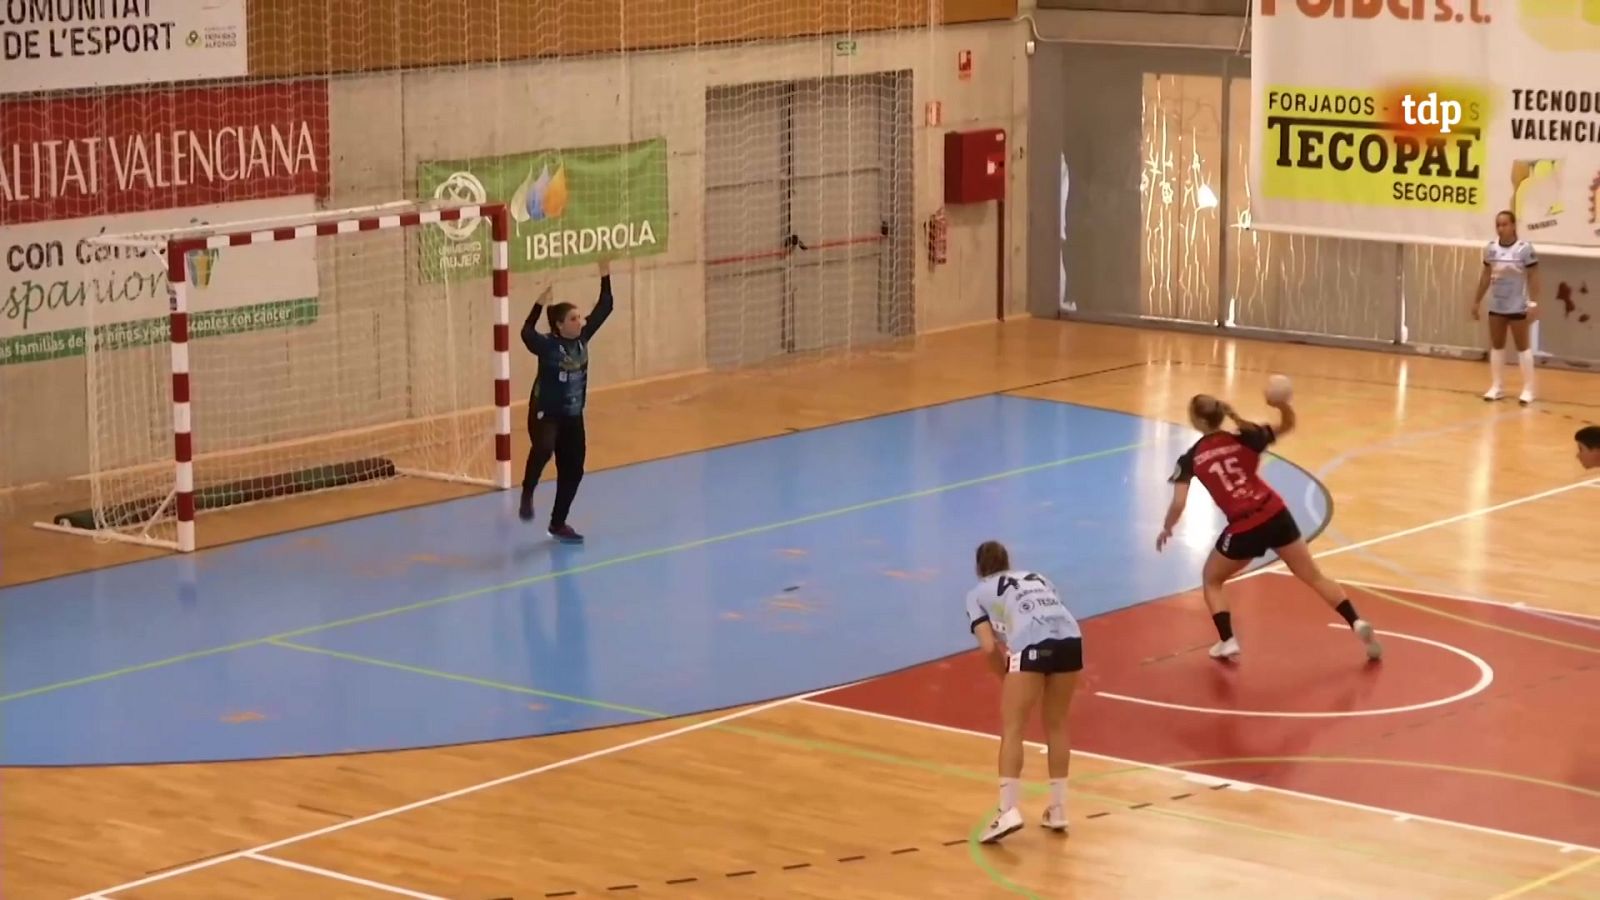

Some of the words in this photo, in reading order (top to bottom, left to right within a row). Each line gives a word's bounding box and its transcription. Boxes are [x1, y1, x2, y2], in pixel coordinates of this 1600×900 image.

[0, 0, 150, 25] OMUNITAT
[4, 30, 40, 60] DE
[49, 22, 176, 57] L'ESPORT
[1269, 92, 1375, 115] FORJADOS
[1267, 116, 1481, 179] TECOPAL
[1511, 118, 1600, 143] VALENCI
[108, 121, 318, 190] VALENCIANA
[1392, 182, 1478, 205] SEGORBE
[6, 239, 64, 273] con
[526, 220, 656, 260] IBERDROLA
[440, 253, 480, 269] MUJER
[1207, 457, 1248, 492] 15
